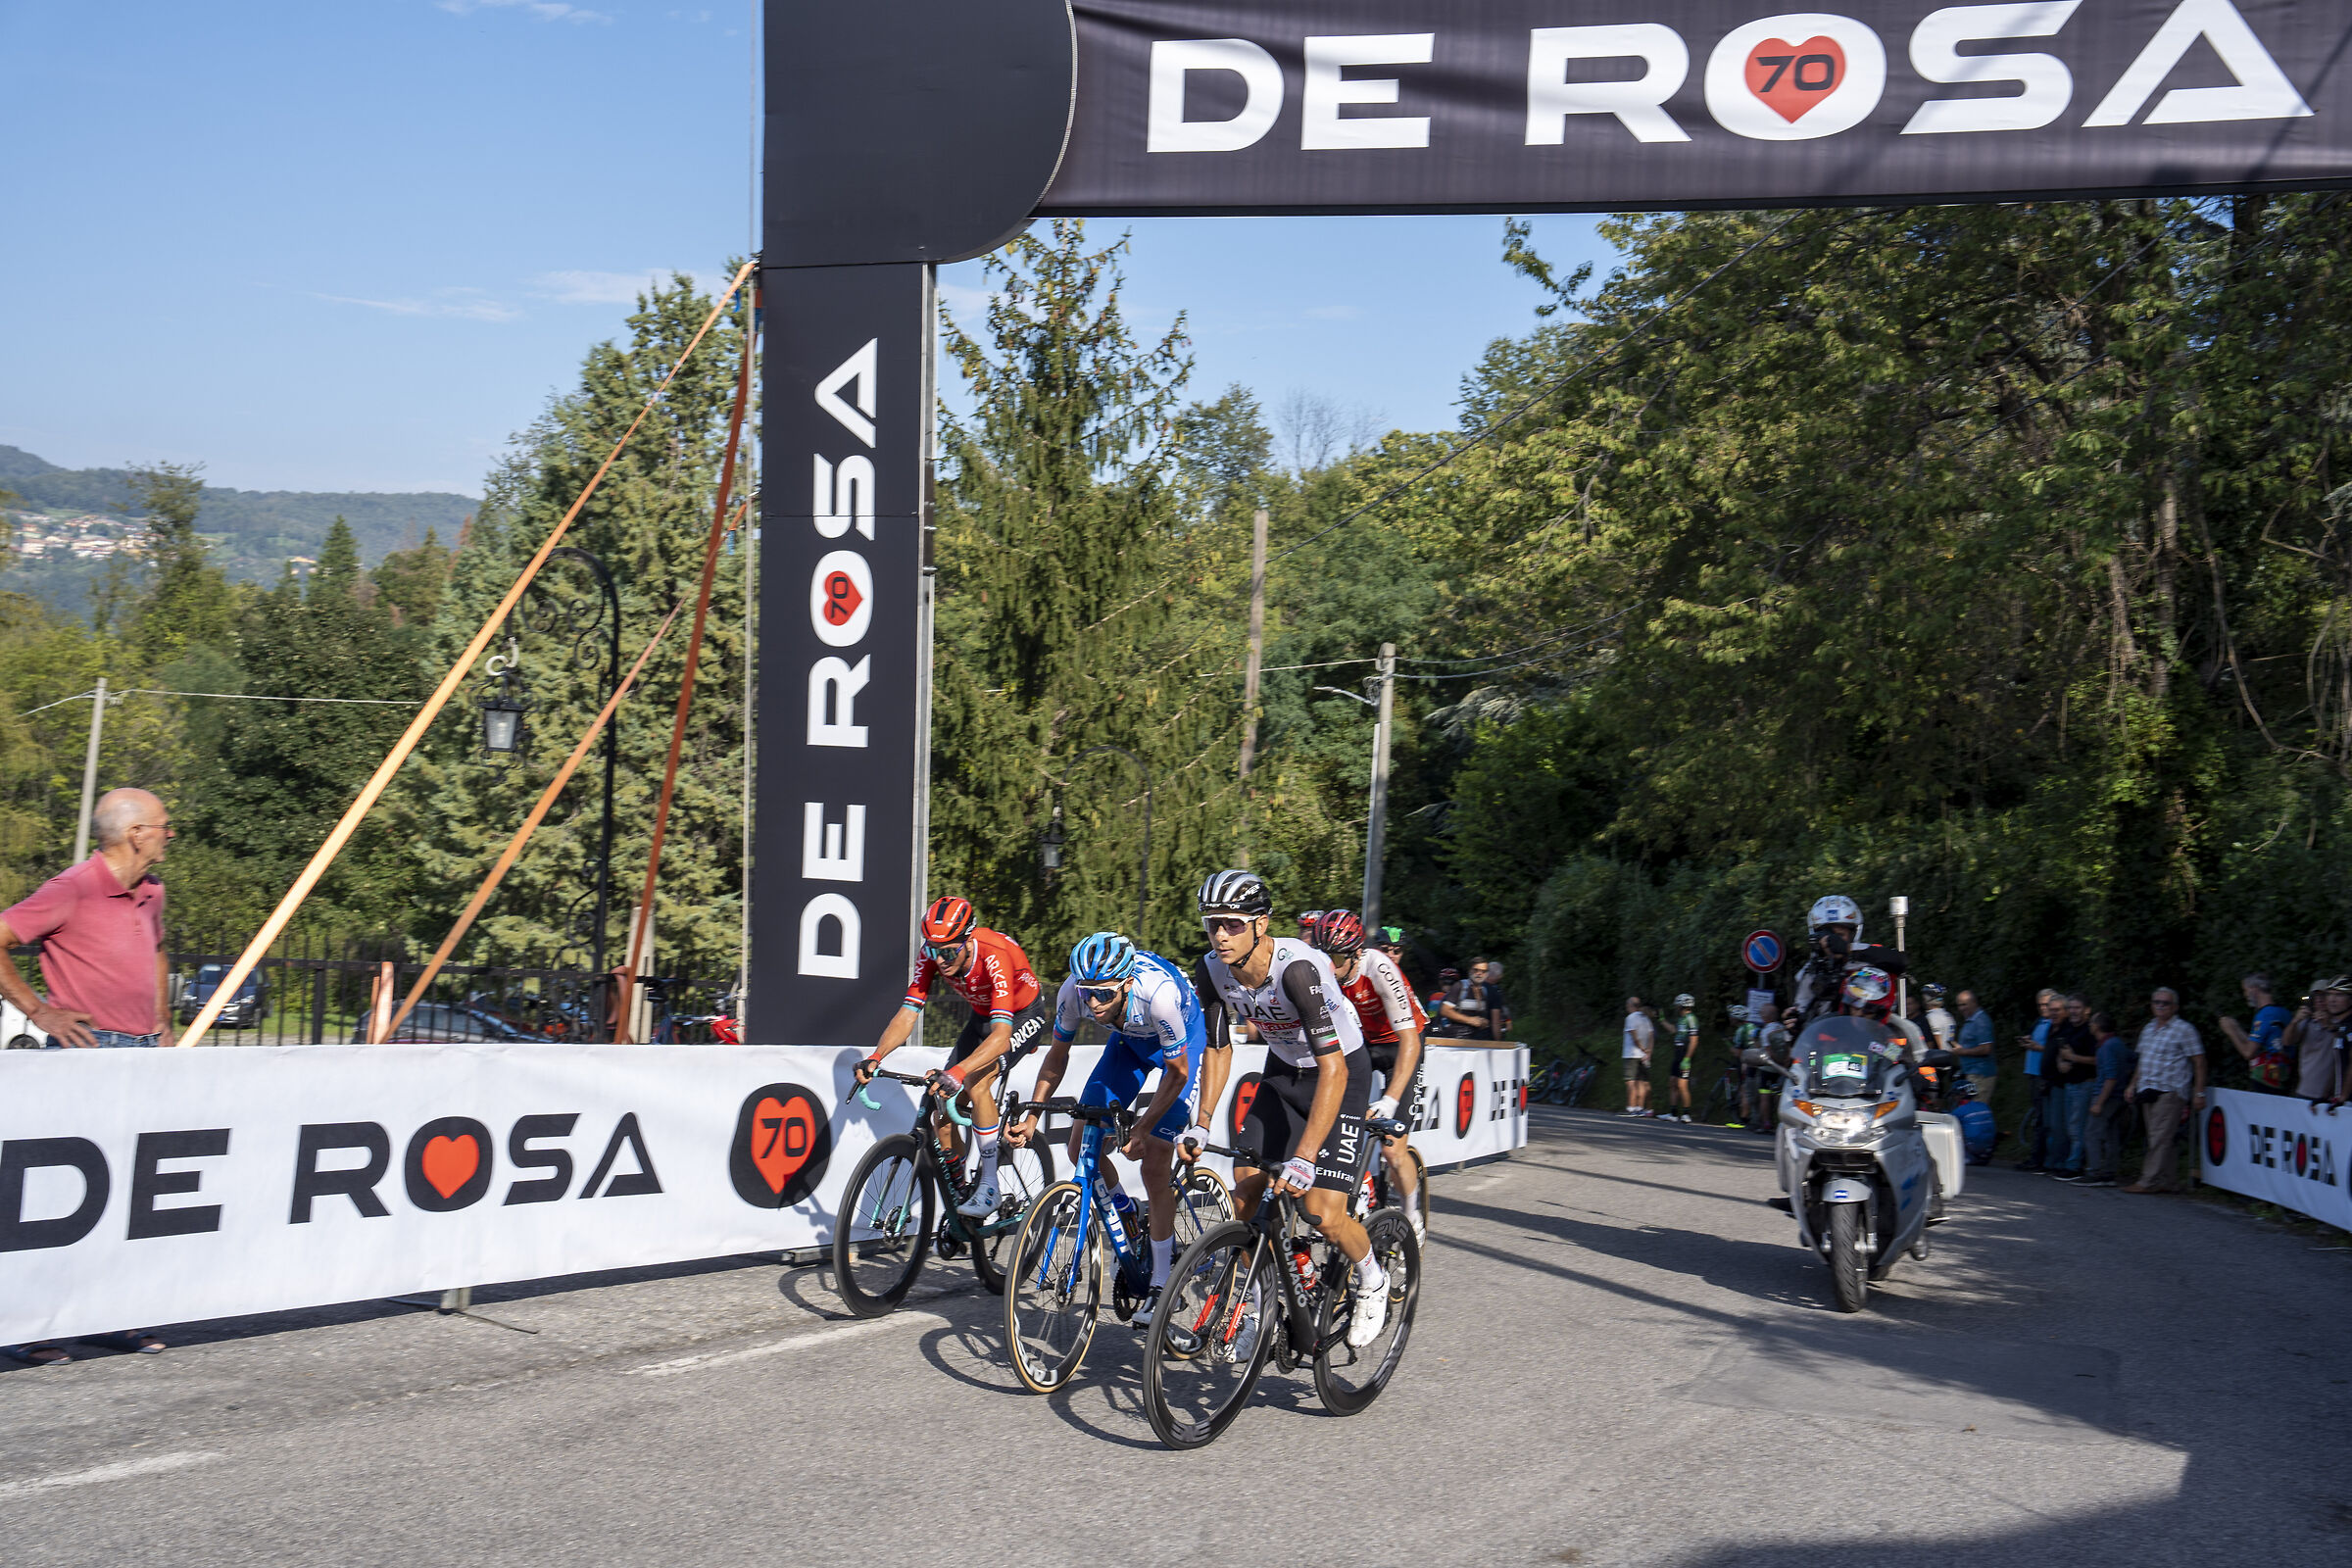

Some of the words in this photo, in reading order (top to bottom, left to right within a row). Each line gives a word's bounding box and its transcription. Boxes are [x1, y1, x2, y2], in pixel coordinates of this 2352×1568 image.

[1147, 33, 1435, 153] DE
[1525, 0, 2314, 146] ROSA
[1755, 53, 1835, 95] 70
[808, 338, 878, 748] ROSA
[831, 576, 849, 619] 70
[798, 802, 866, 979] DE
[984, 954, 1008, 998] ARKEA
[1377, 962, 1408, 1010] Cofidis
[1233, 1003, 1292, 1021] UAE
[1009, 1017, 1042, 1053] ARKEA
[760, 1116, 807, 1159] 70
[1336, 1122, 1360, 1164] UAE
[0, 1129, 229, 1252] DE
[289, 1111, 662, 1225] ROSA
[1279, 1227, 1308, 1308] COLNAGO
